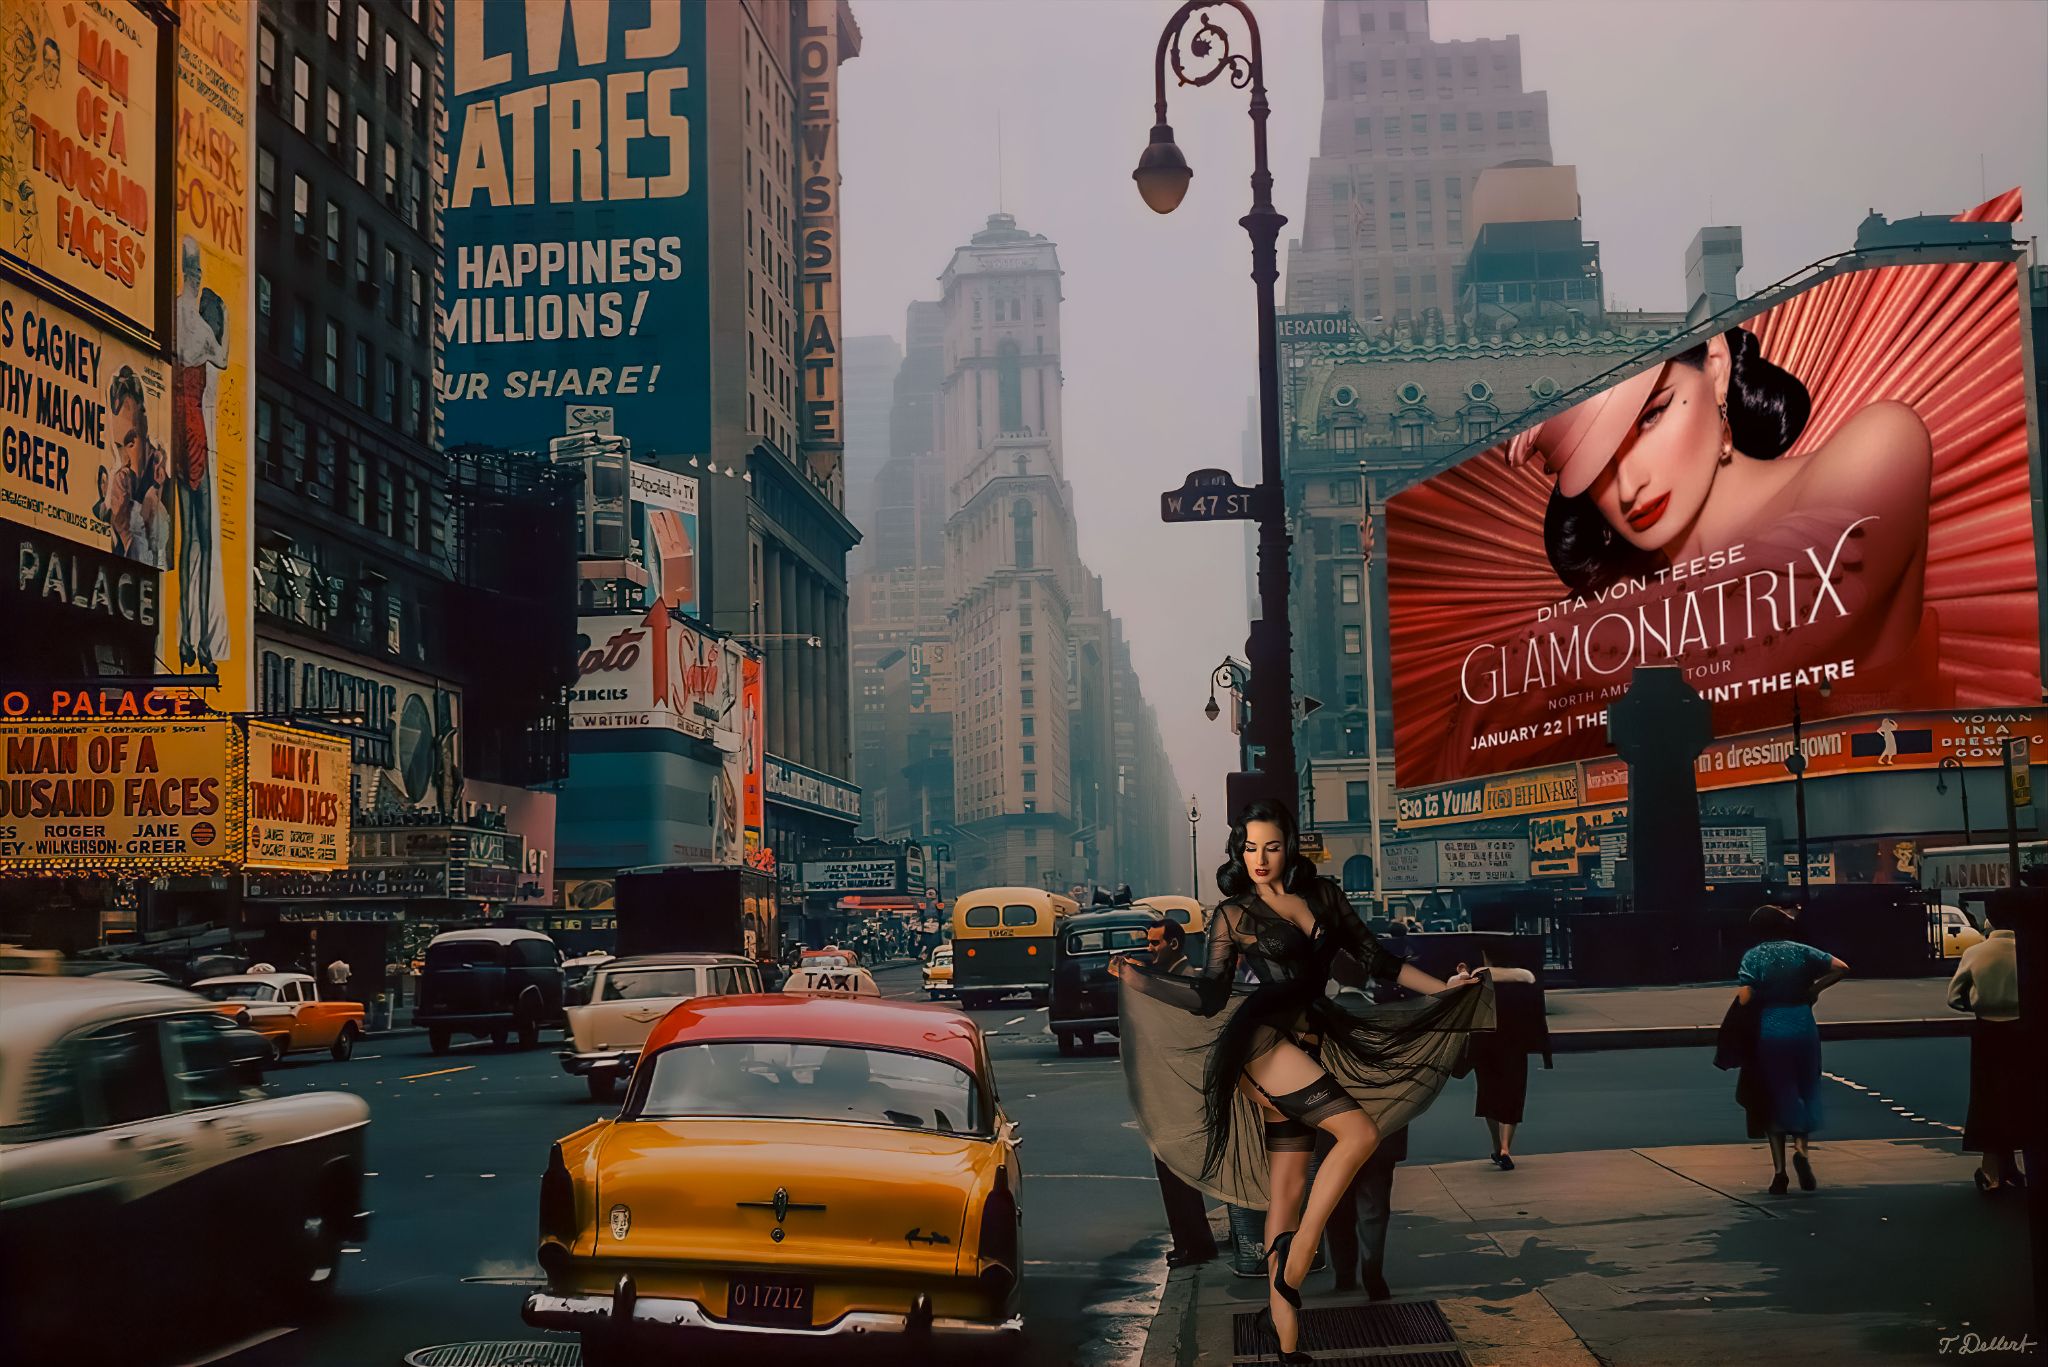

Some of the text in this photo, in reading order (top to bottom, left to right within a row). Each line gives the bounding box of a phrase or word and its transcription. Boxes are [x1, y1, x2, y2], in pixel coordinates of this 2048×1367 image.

[77, 20, 129, 108] MAN
[76, 86, 108, 148] OF
[107, 110, 128, 166] A
[443, 67, 690, 208] ATRES
[30, 112, 149, 236] THOUSAND
[57, 194, 135, 289] FACES
[457, 236, 682, 289] HAPPINESS
[22, 310, 101, 389] CAGNEY
[802, 229, 835, 439] STATE
[1278, 319, 1347, 336] ERATON
[503, 365, 661, 397] SHARE!
[36, 376, 106, 450] MALONE
[1, 425, 69, 495] GREER
[1167, 494, 1251, 516] W 47 ST
[19, 541, 154, 626] PALACE
[1537, 544, 1746, 623] DITA VON TEESE
[1461, 515, 1881, 705] GLAMONATRIX
[52, 690, 191, 716] PALACE
[1470, 723, 1539, 750] JANUARY
[1543, 719, 1562, 737] 22
[1576, 709, 1607, 731] THE
[1747, 658, 1855, 697] THEATRE
[1548, 690, 1594, 711] NORTH
[1685, 660, 1732, 680] TOUR
[582, 714, 650, 726] WRITING
[1952, 713, 2033, 724] WOMAN
[1964, 723, 2010, 736] IN A
[7, 736, 159, 774] MAN OF A
[1714, 751, 1724, 771] a
[1955, 748, 2003, 757] GOW
[124, 777, 220, 817] FACES
[1424, 793, 1439, 817] to
[1442, 789, 1482, 815] YUMA
[44, 825, 106, 837] ROGER
[132, 824, 180, 837] JANE
[126, 840, 187, 854] GREER
[804, 972, 859, 992] TAXI
